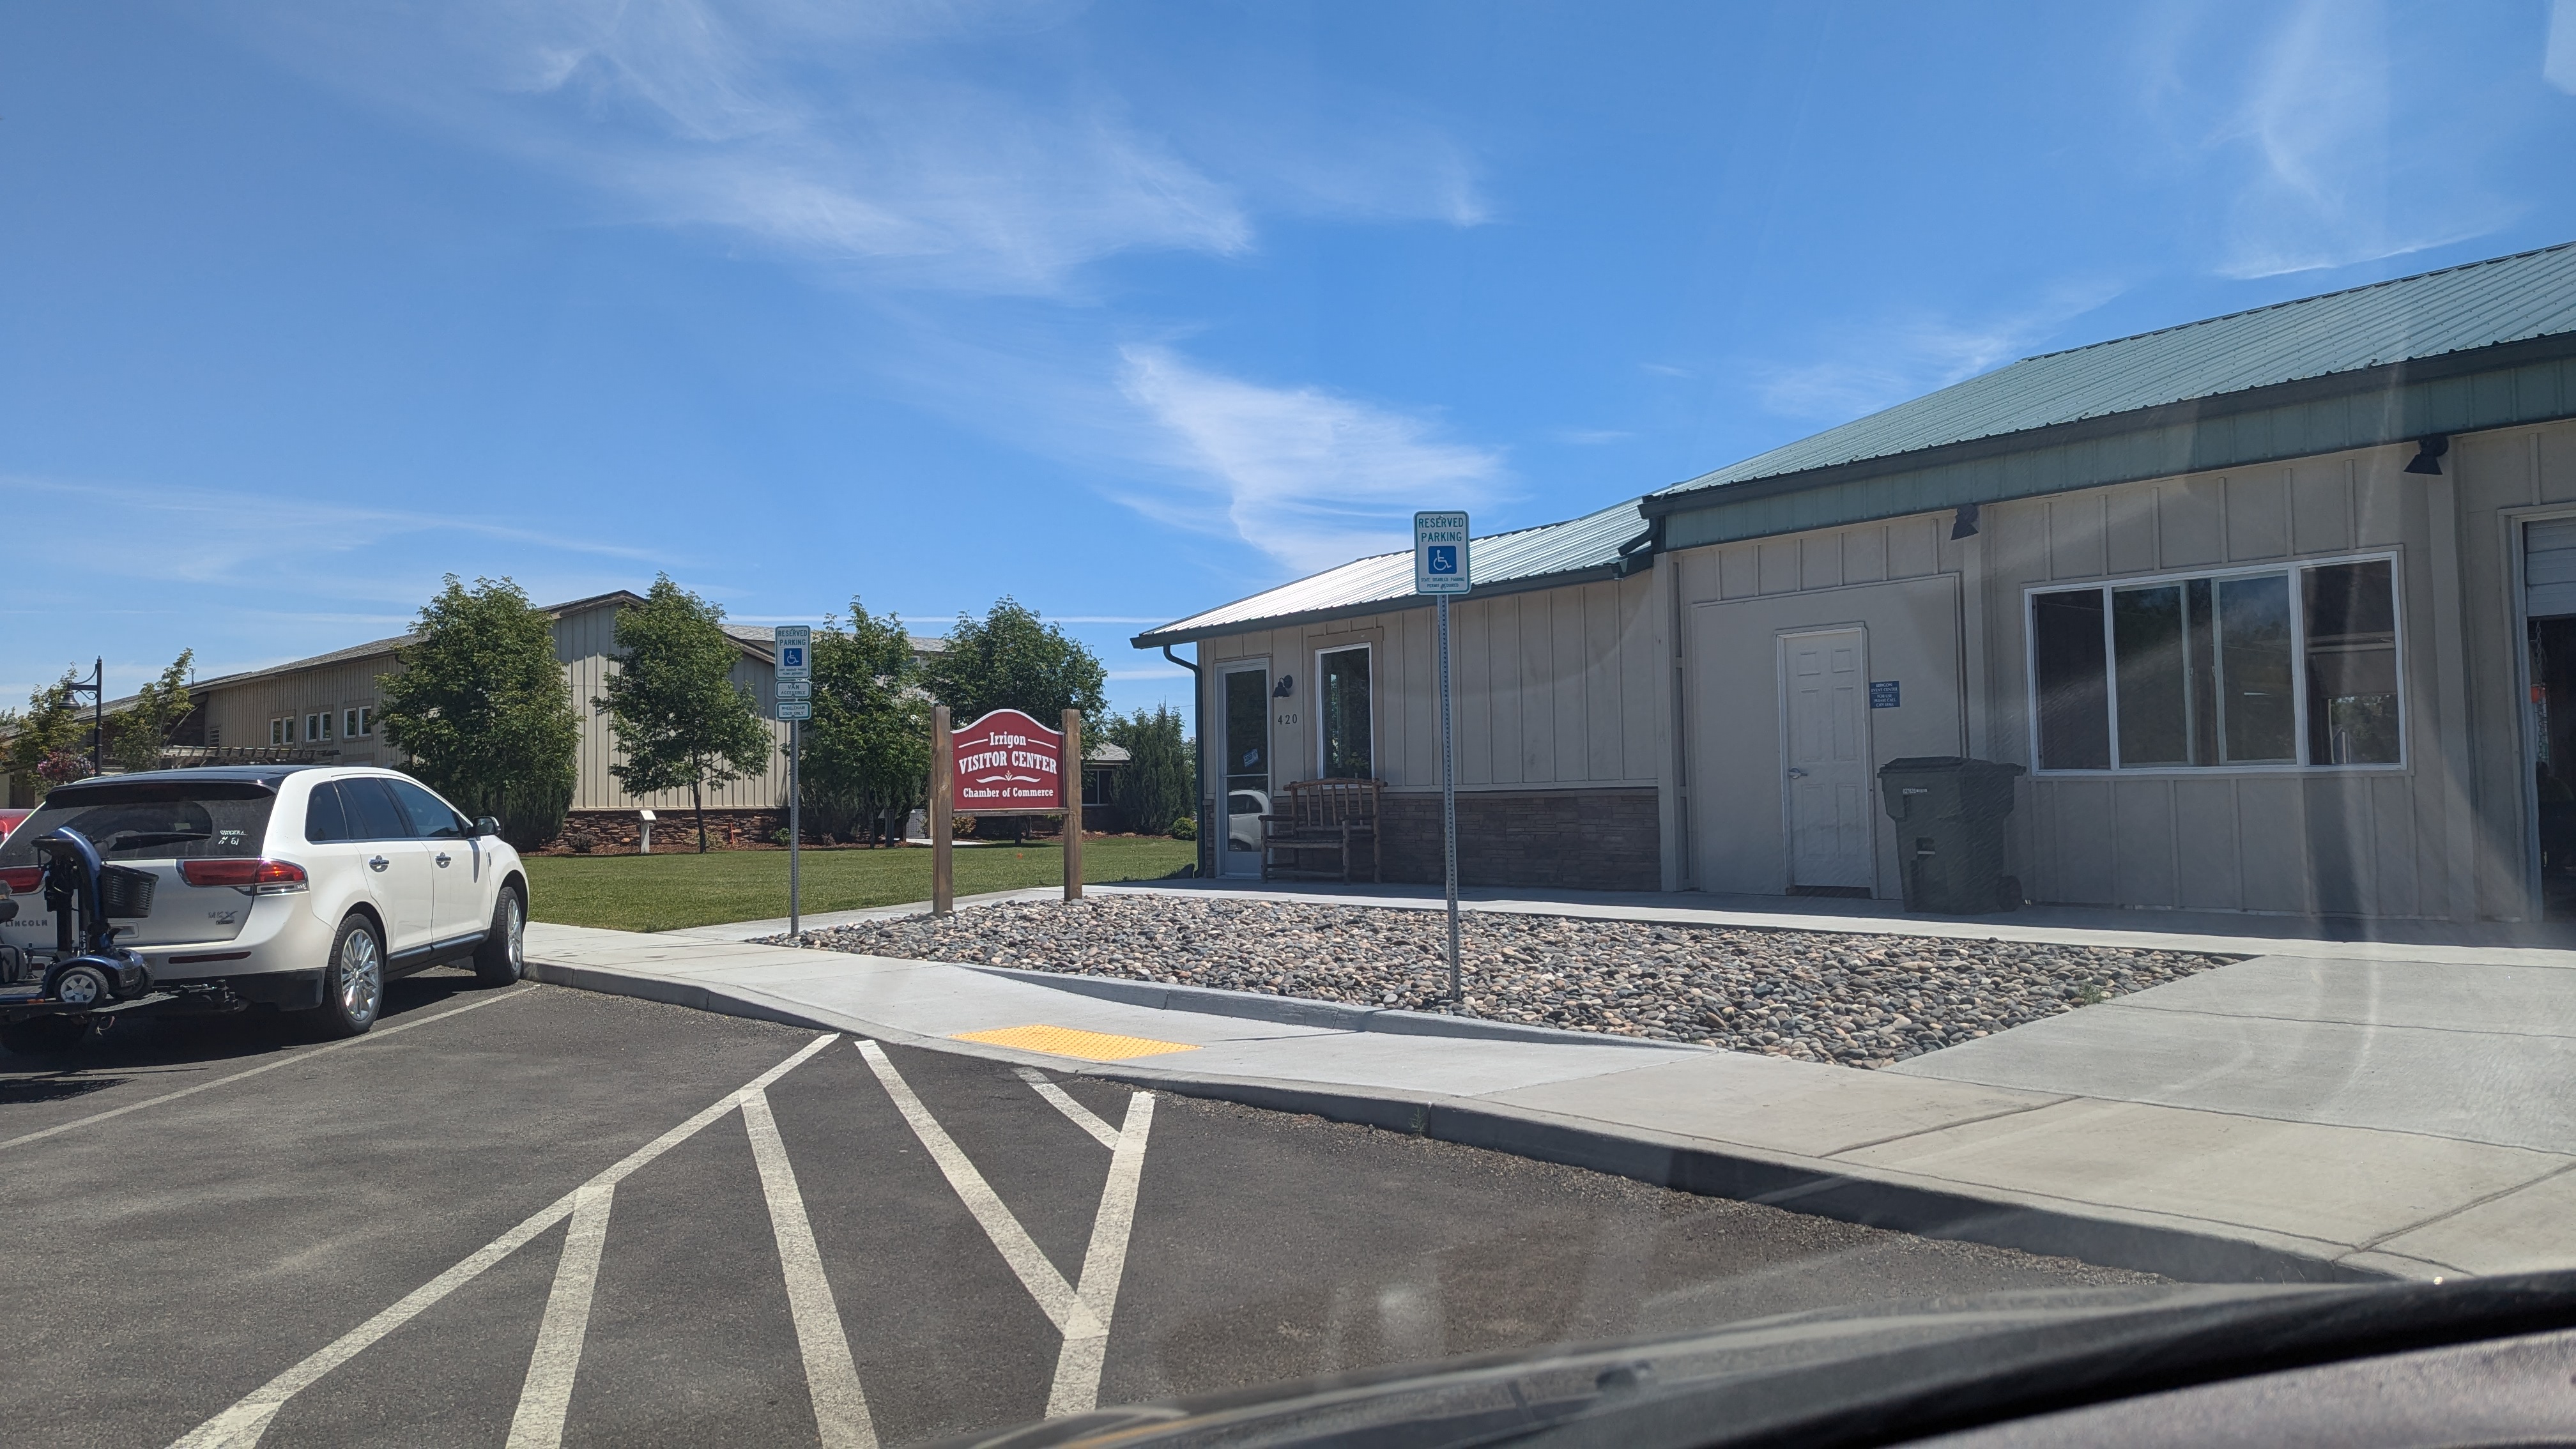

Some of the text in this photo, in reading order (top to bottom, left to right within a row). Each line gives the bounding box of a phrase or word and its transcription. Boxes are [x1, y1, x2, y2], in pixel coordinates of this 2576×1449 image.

[1418, 518, 1464, 528] RESERVED
[1421, 532, 1462, 542] PARKING
[1278, 714, 1298, 724] 420
[990, 731, 1027, 748] Irrigon
[959, 750, 1057, 774] VISITOR CENTER
[963, 787, 1054, 797] Chamber of Commerce
[208, 910, 238, 921] MKX
